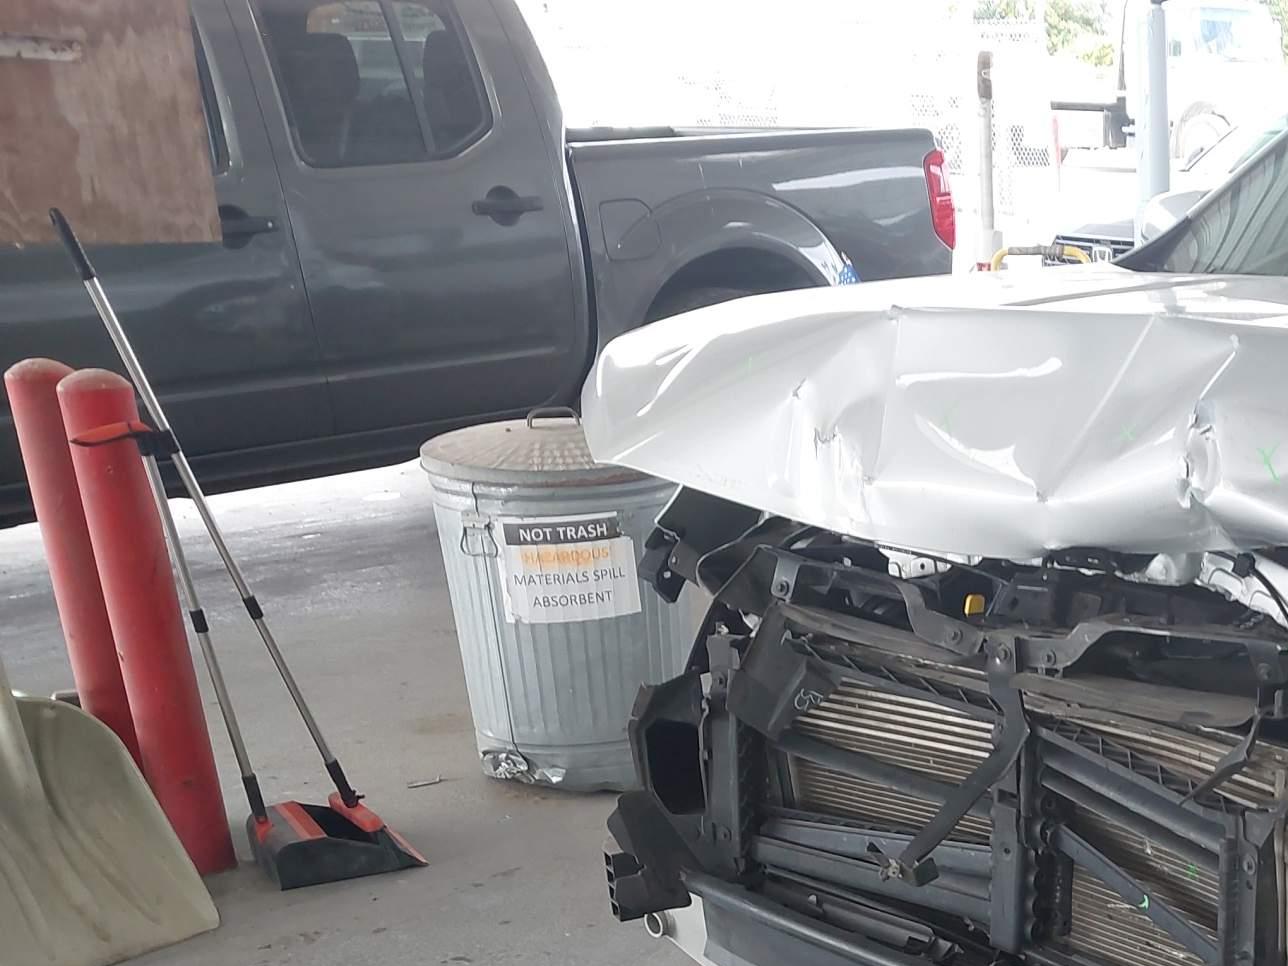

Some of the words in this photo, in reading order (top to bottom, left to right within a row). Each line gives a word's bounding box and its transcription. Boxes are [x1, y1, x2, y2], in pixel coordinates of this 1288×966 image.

[519, 527, 553, 542] NOT
[556, 522, 608, 541] TRASH
[513, 570, 589, 586] MATERIALS
[592, 567, 626, 582] SPILL
[533, 590, 612, 608] ABSORBENT
